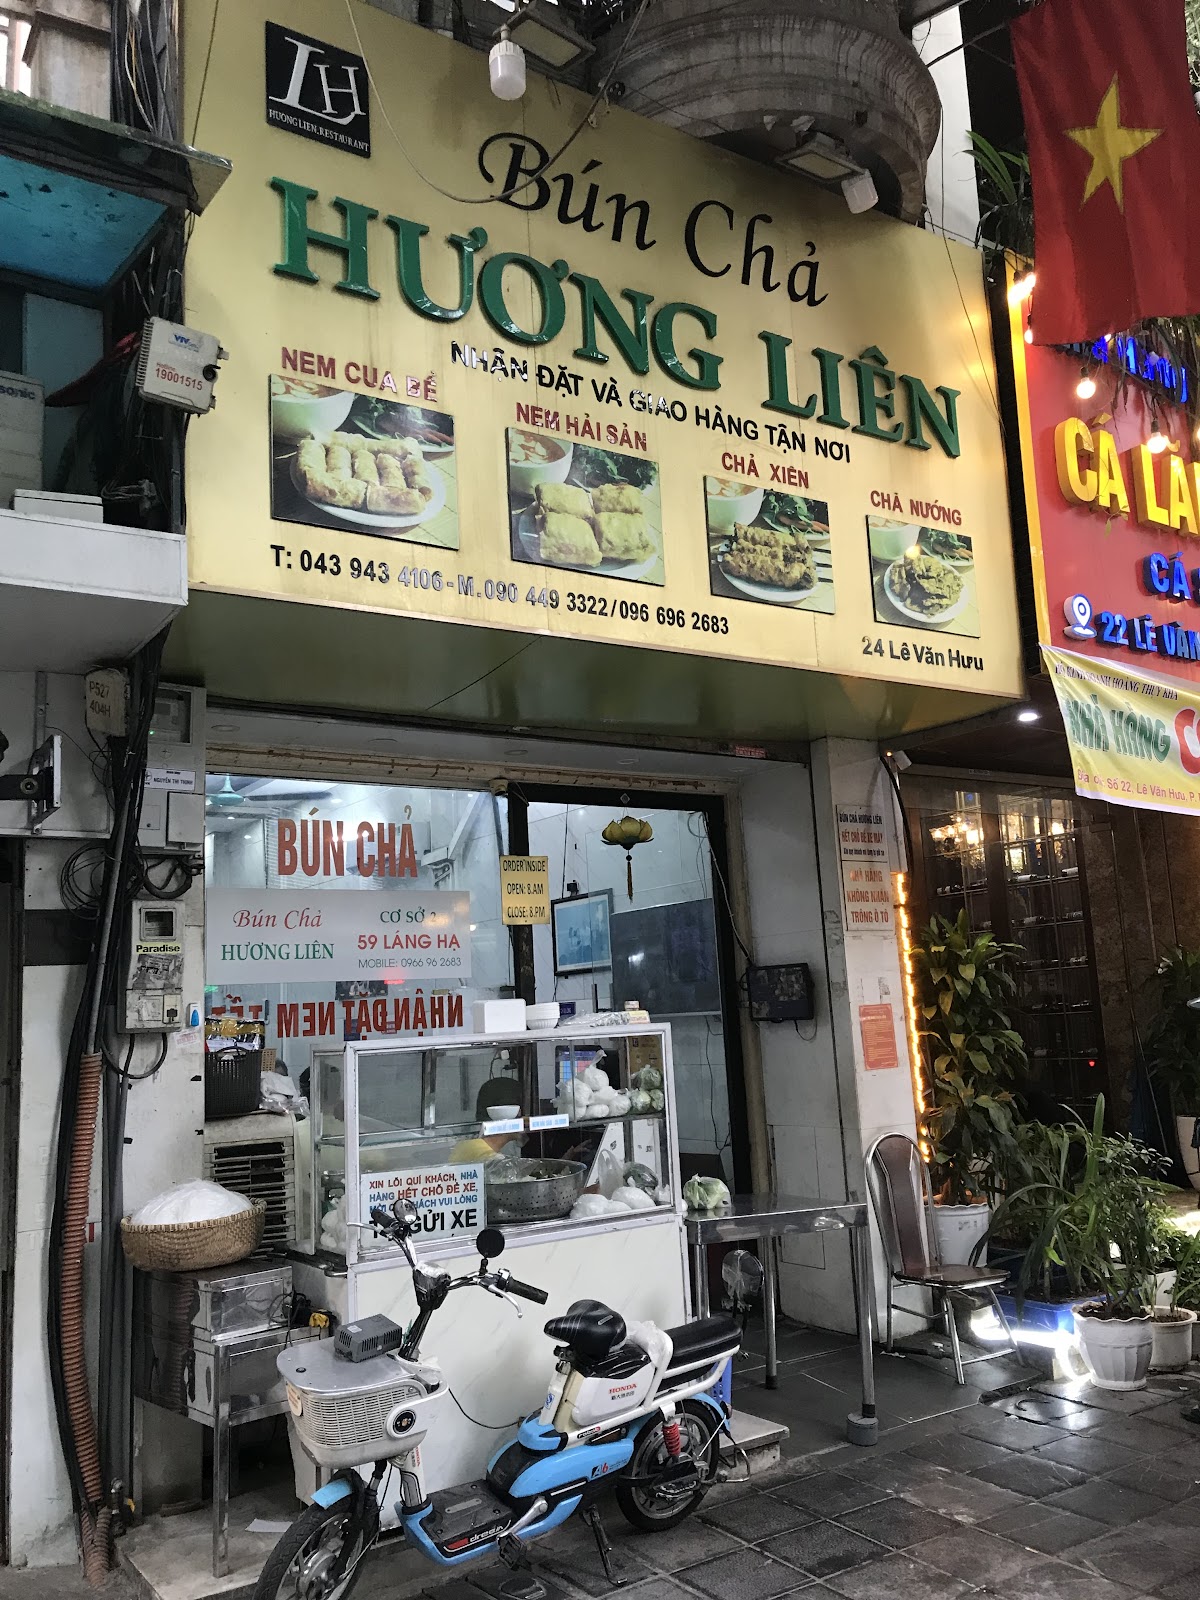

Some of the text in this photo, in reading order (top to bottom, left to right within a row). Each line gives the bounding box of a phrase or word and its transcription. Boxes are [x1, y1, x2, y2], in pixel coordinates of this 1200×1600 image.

[478, 132, 829, 307] Bún Chả
[270, 176, 962, 458] HƯƠNG LIÊN
[155, 367, 203, 391] 19001515
[281, 346, 336, 379] NEM
[344, 361, 397, 393] CUA
[450, 340, 852, 463] NHẬN ĐẶT VÀ GIAO HÀNG TẬN NƠI
[516, 402, 648, 452] NEM HẢI SẢN
[721, 452, 810, 489] CHẢ XIÊN
[1055, 412, 1131, 513] CÁ
[870, 490, 963, 527] CHẢ NƯỚNG
[1144, 551, 1192, 600] CÁ
[270, 544, 292, 569] T:
[300, 549, 341, 576] 043
[350, 557, 390, 584] 943
[526, 586, 560, 609] 449
[656, 606, 686, 628] 696
[691, 611, 730, 635] 2683
[1096, 611, 1129, 646] 22
[1128, 614, 1158, 652] LÊ
[862, 636, 985, 672] 24 Lê Văn Hưu
[89, 681, 110, 699] P527
[1112, 676, 1139, 693] HOÀNG
[89, 701, 111, 719] 404H
[1110, 702, 1171, 763] HÀNG
[1107, 777, 1119, 791] Số
[1136, 782, 1148, 795] Lê
[1150, 785, 1167, 798] Văn
[277, 804, 418, 878] BÚN CHẢ
[503, 860, 546, 872] ORDER INSIDE
[864, 867, 884, 882] HÀNG
[507, 883, 544, 895] OPEN: 8.AM
[846, 888, 870, 903] KHÔNG
[233, 907, 323, 930] Bún Chả
[380, 906, 437, 924] CƠ SỞ 2
[507, 906, 546, 918] CLOSE: 8.PM
[874, 908, 879, 923] Ô
[880, 908, 889, 923] TÔ
[136, 945, 180, 953] Paradise
[221, 940, 334, 960] HƯƠNG LIÊN
[357, 930, 461, 952] 59 LÁNG HẠ
[358, 957, 462, 969] MOBILE: 0966 96 2683
[369, 1169, 479, 1190] XIN LỖI QUÍ KHÁCH, NHÀ
[369, 1191, 395, 1203] HÀNG
[398, 1186, 419, 1201] HẾT
[421, 1184, 444, 1197] CHỖ
[463, 1182, 479, 1193] XE,
[439, 1196, 453, 1206] VUI
[455, 1194, 479, 1205] LÒNG
[451, 1208, 478, 1230] XE
[609, 1383, 637, 1394] HONDA
